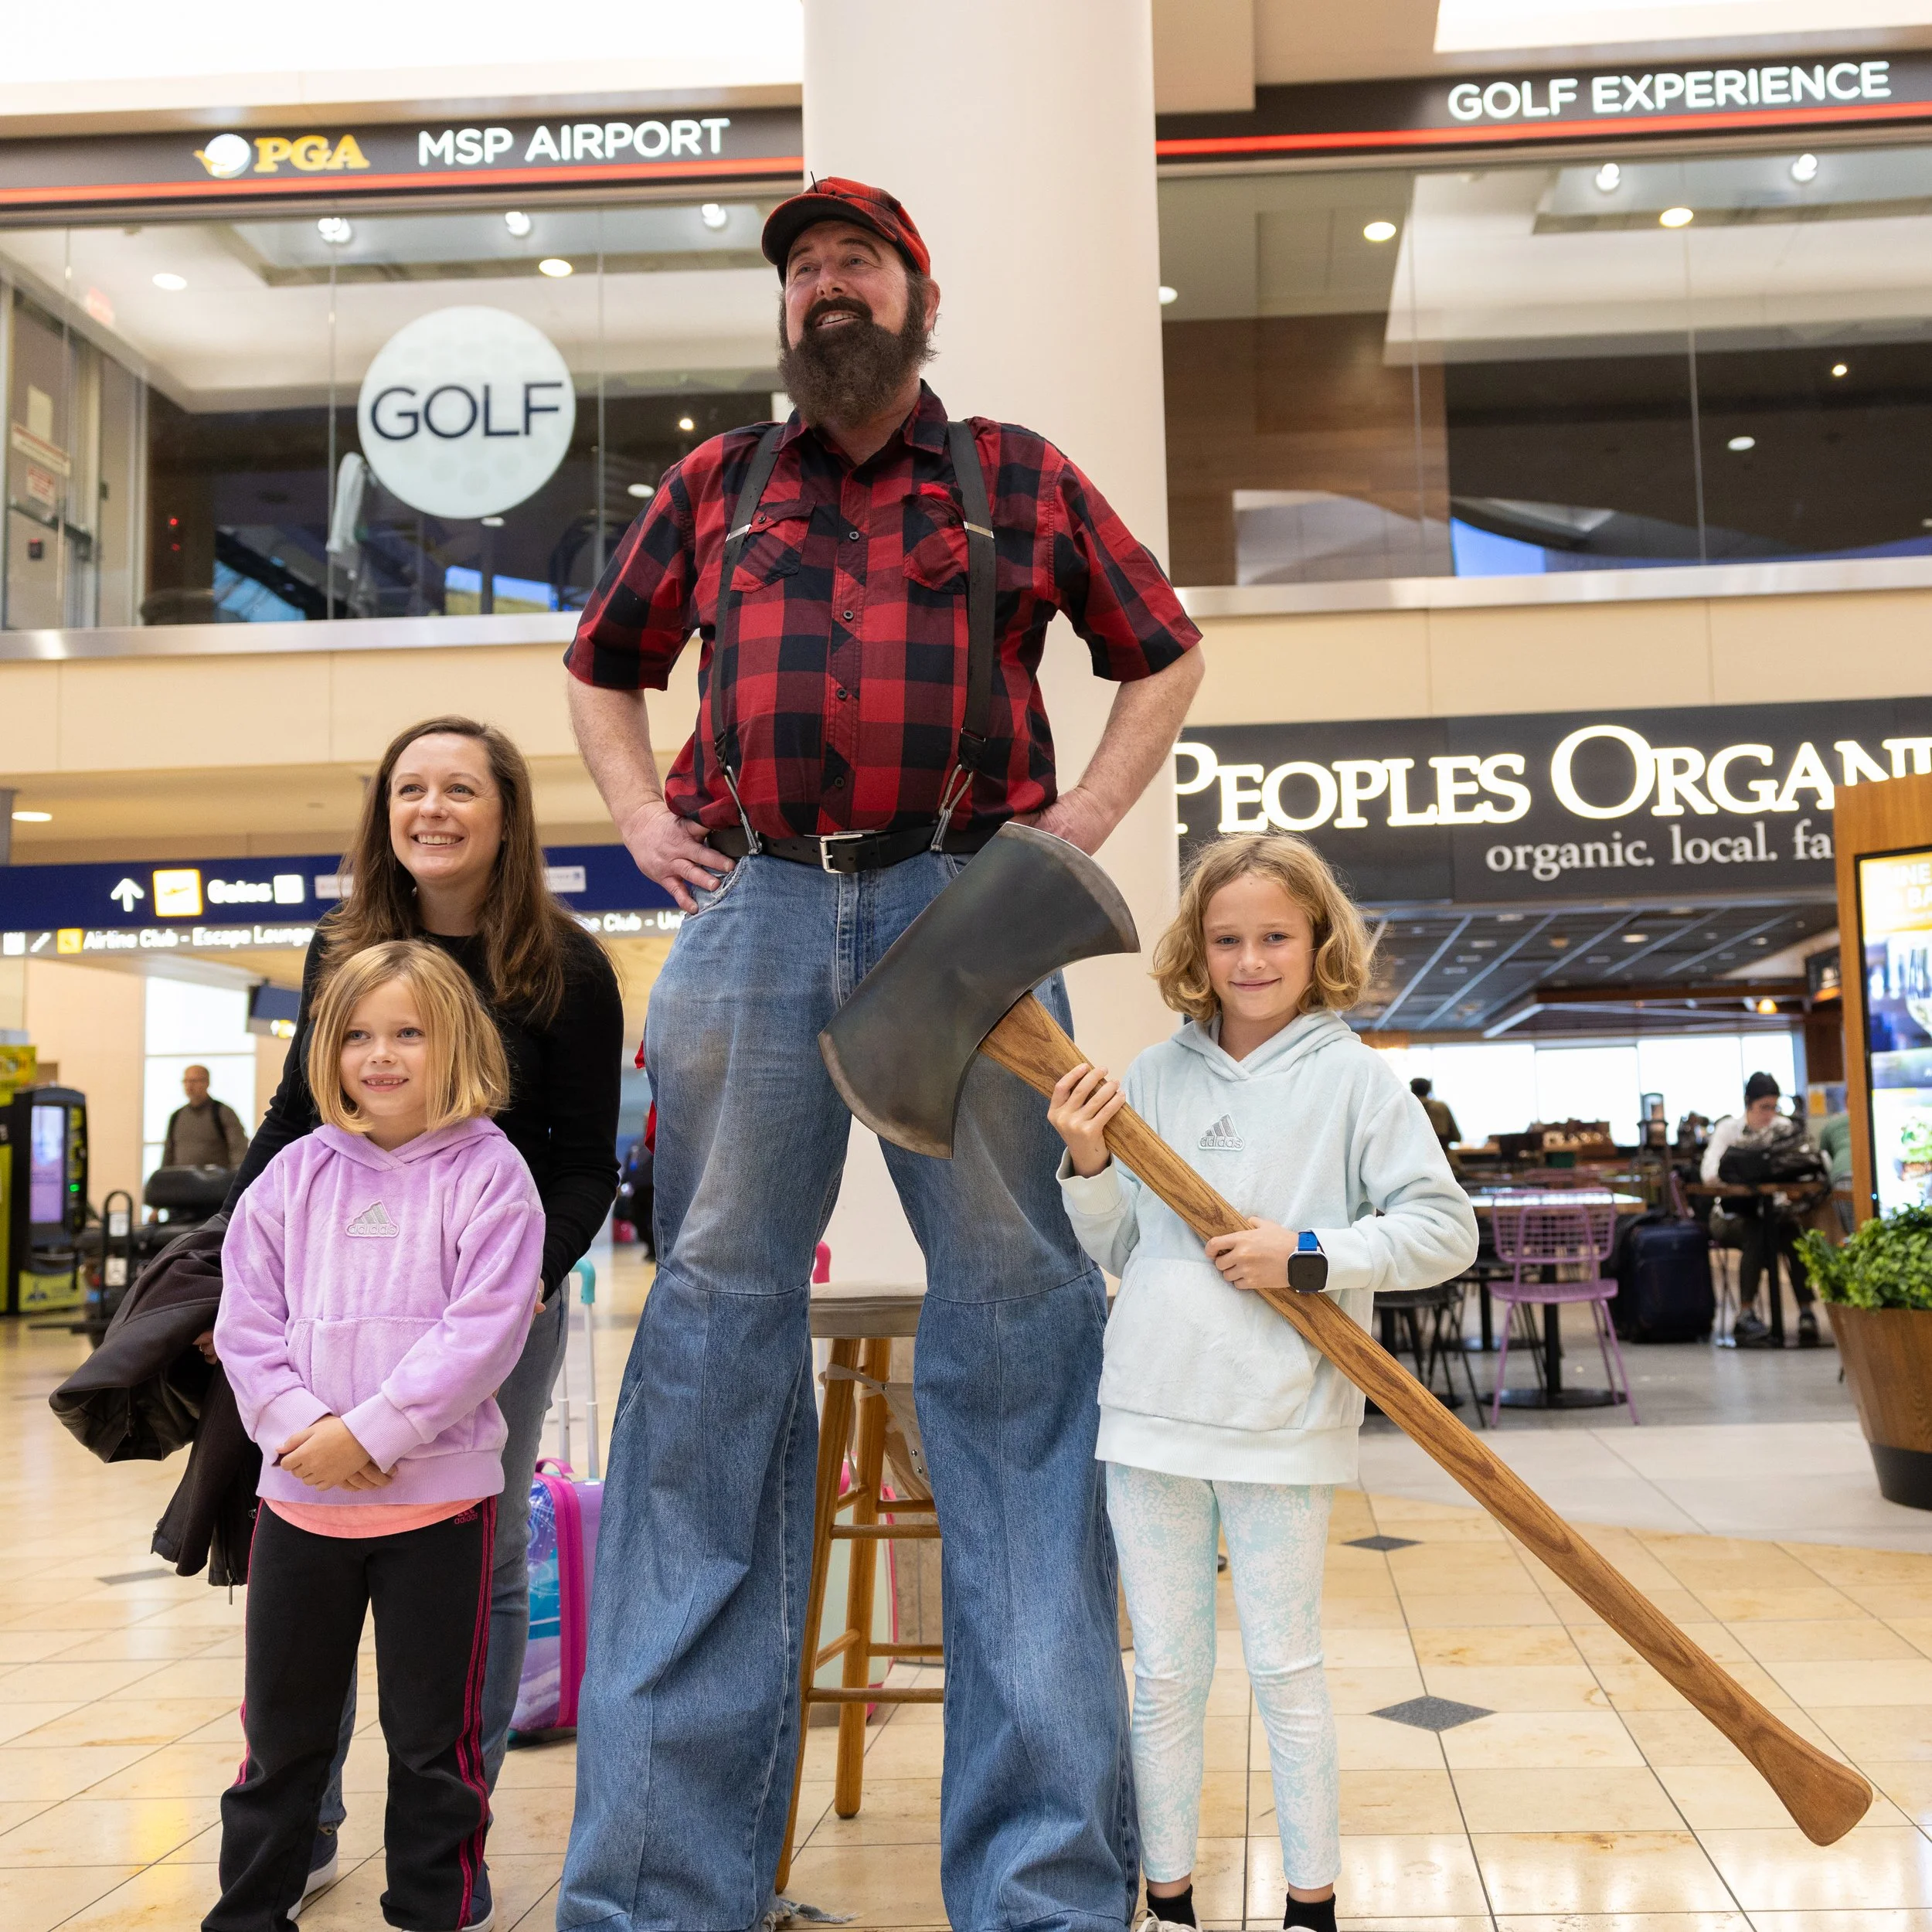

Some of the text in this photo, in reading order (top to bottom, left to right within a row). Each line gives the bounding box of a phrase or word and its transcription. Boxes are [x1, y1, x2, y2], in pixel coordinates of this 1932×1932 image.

[1447, 61, 1892, 120] GOLF EXPERIENCE
[418, 117, 730, 166] MSP AIRPORT
[253, 134, 371, 174] PGA
[370, 381, 563, 440] GOLF
[1485, 831, 1655, 881] organic.
[1669, 821, 1777, 865] local.
[207, 879, 273, 903] Gates
[603, 913, 642, 932] Club
[83, 930, 137, 950] Airline
[140, 928, 179, 948] Club
[192, 927, 251, 949] Escape
[1200, 1135, 1243, 1148] adidas
[348, 1223, 397, 1235] adidas
[454, 1512, 478, 1525] adidas
